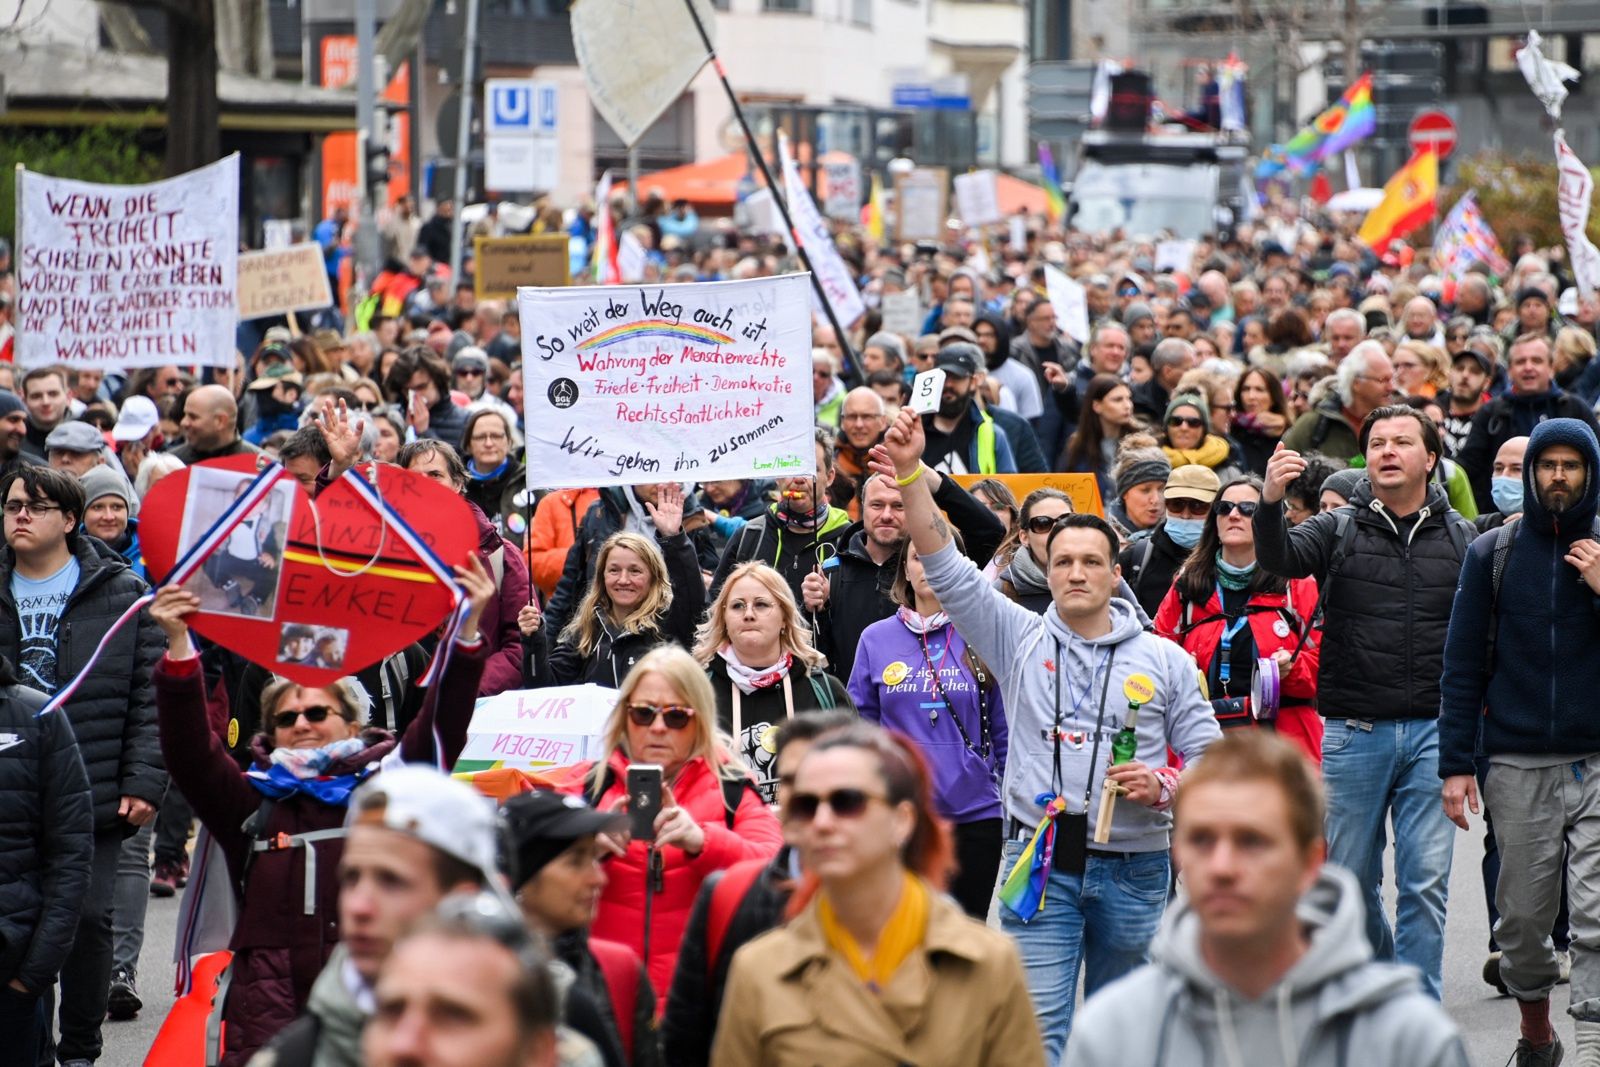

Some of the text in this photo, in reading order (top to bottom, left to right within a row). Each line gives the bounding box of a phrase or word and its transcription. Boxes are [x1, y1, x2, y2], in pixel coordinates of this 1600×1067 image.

[46, 191, 158, 218] WENN DIE
[65, 209, 184, 247] FREIHEIT
[23, 244, 122, 271] SCHREIEN
[91, 274, 110, 292] DIE
[170, 265, 223, 286] BEBEN
[18, 289, 233, 316] UND EIN GEWALTIGER STURM
[25, 310, 174, 334] DIE MENSCHHEIT
[536, 334, 565, 361] So
[568, 306, 601, 341] weit
[604, 297, 629, 320] der
[639, 288, 683, 326] Weg
[693, 307, 733, 332] auch
[649, 346, 674, 367] der
[680, 345, 787, 369] Menschenrechte
[921, 376, 936, 397] g
[616, 401, 765, 425] Rechtsstaatlichkeit
[559, 414, 784, 477] Wir gehen ihn zusammen
[285, 573, 427, 627] ENKEL
[939, 666, 961, 677] mir
[517, 697, 576, 719] WIR
